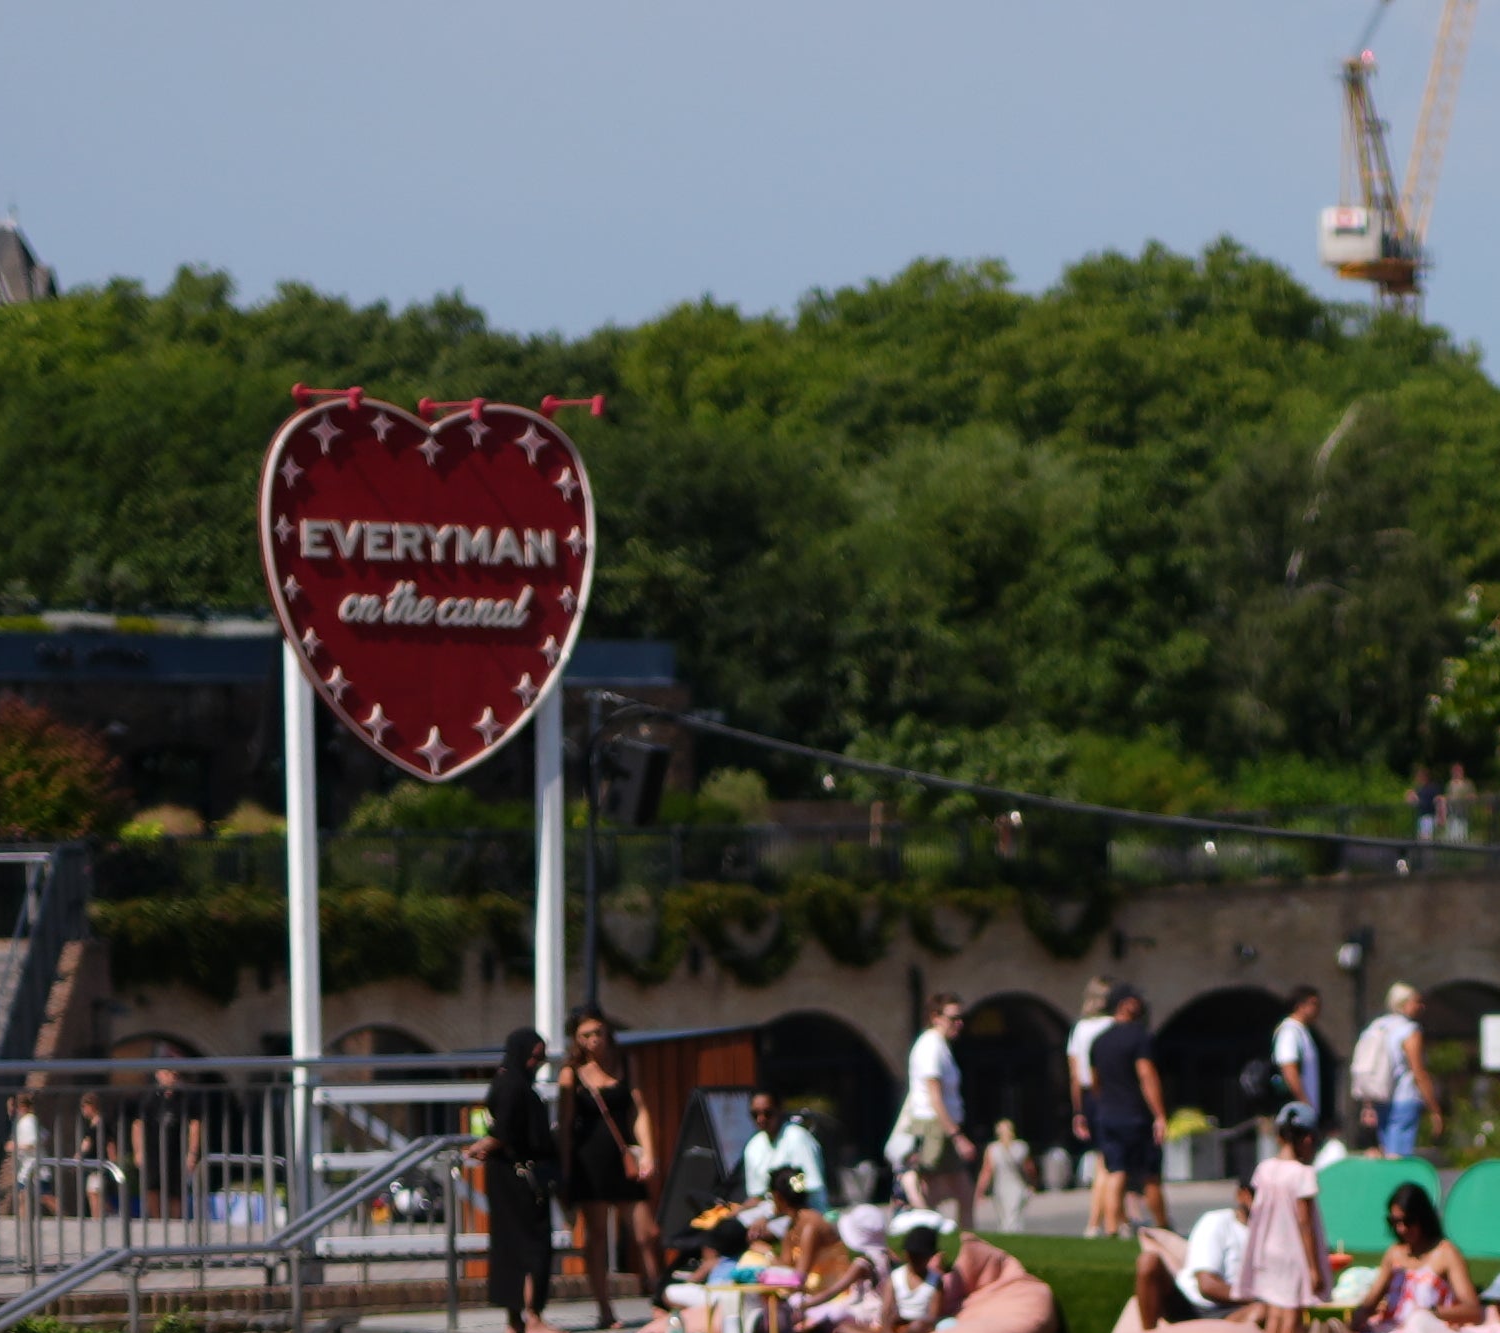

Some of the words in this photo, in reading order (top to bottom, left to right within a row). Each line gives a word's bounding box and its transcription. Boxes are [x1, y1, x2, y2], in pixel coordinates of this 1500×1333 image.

[301, 519, 556, 567] EVERYMAN
[339, 592, 382, 623] on
[384, 580, 435, 624] the
[435, 585, 533, 627] canal
